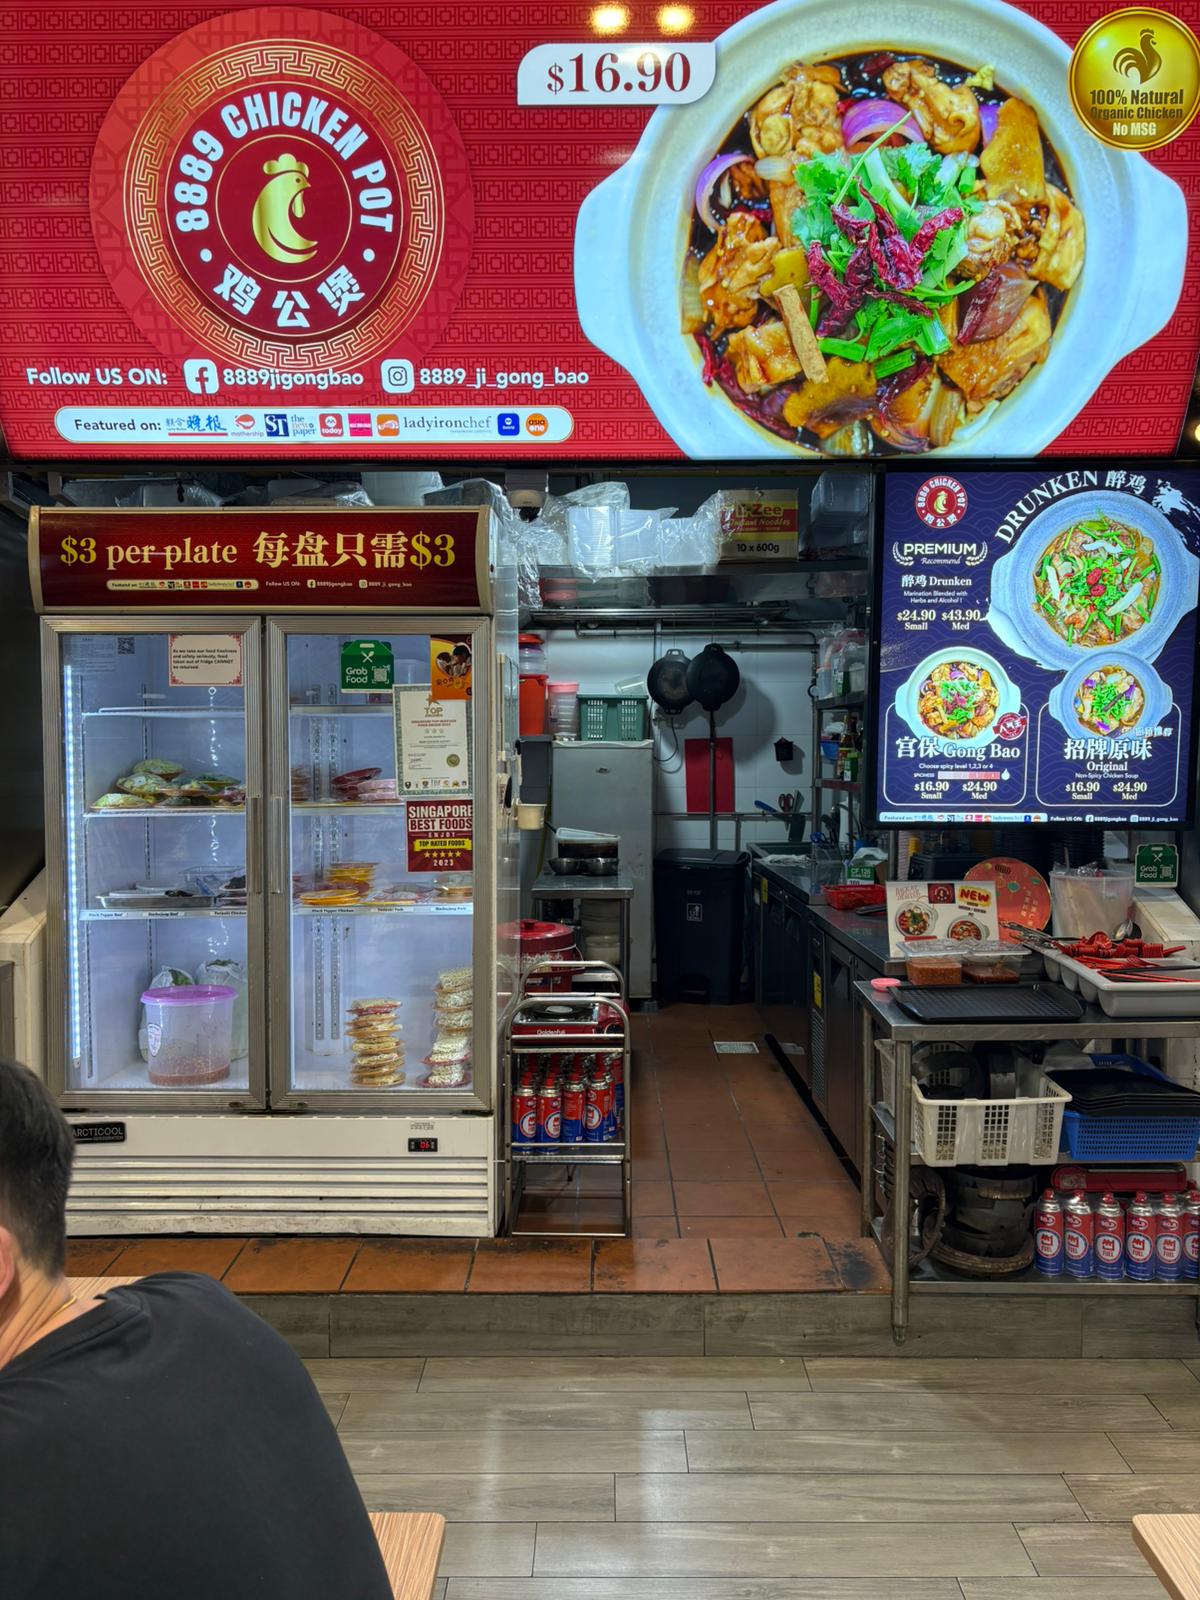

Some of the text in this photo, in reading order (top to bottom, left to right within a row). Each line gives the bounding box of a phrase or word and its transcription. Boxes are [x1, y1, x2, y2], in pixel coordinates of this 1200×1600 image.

[547, 51, 691, 95] $16.90
[1089, 89, 1184, 105] 100% Natural
[1090, 106, 1183, 121] Organic Chicken
[1112, 122, 1157, 136] No MSG
[174, 91, 394, 233] 8889 CHICKEN POT
[213, 263, 366, 328] 鸡公煲
[26, 367, 168, 385] Follow US ON:
[222, 366, 365, 389] 8889jigongbao
[419, 366, 590, 389] 8889_ji_gong_bao
[75, 419, 162, 431] Featured on:
[266, 414, 289, 437] ST
[403, 416, 492, 431] ladyironchef
[321, 427, 343, 436] today
[995, 470, 1099, 545] DRUNKEN
[60, 535, 238, 570] $3 per plate
[737, 543, 748, 552] 10
[756, 543, 780, 553] 600g
[903, 543, 977, 556] PREMIUM
[921, 556, 962, 565] Recommend
[929, 576, 972, 586] Drunken
[897, 609, 980, 621] $24.90 $43.90
[904, 622, 970, 630] Small Med
[345, 666, 368, 676] Grab
[345, 675, 368, 684] Food
[943, 742, 1020, 761] Gong Bao
[1063, 738, 1152, 760] 招牌原味
[1086, 761, 1128, 772] Original
[914, 781, 997, 792] $16.90 $24.90
[1065, 782, 1148, 793] $16.90 $24.90
[1072, 793, 1093, 801] Small
[408, 805, 472, 818] SINGAPORE
[410, 818, 472, 830] BEST FOODS
[960, 888, 990, 903] NEW
[72, 1126, 125, 1138] ARCTICOOL
[1131, 1249, 1143, 1257] FUEL
